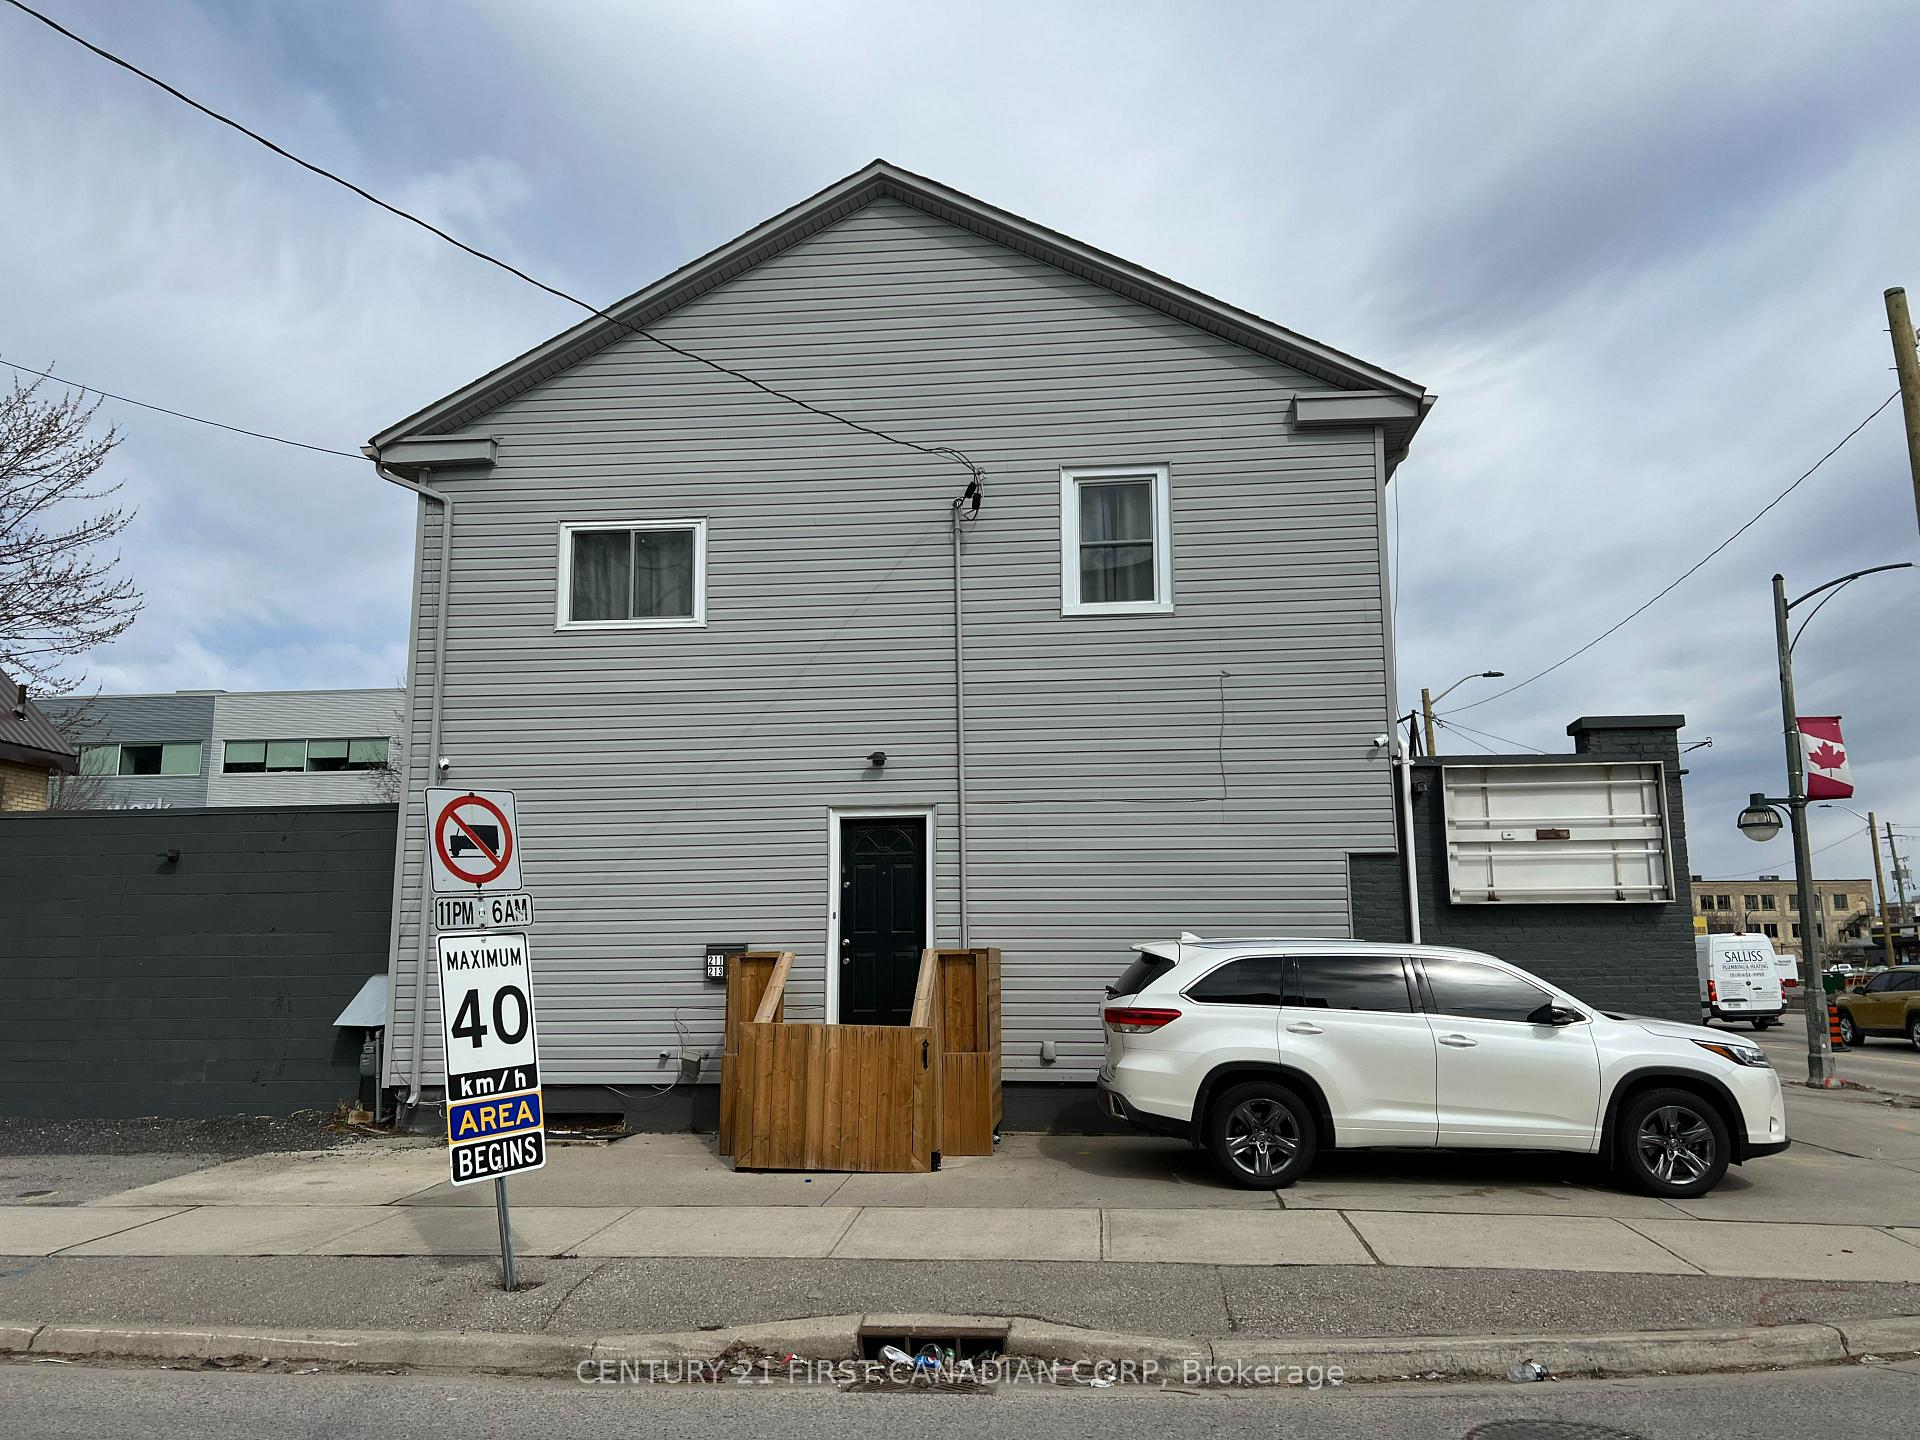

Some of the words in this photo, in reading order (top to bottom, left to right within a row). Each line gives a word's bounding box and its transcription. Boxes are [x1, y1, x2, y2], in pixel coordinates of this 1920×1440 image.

[438, 901, 474, 926] 11PM
[446, 947, 522, 971] MAXIMUM
[708, 955, 723, 965] 211
[1724, 950, 1763, 963] SALLISS
[708, 967, 723, 976] 213
[451, 985, 529, 1049] 40
[460, 1068, 527, 1097] km/h
[458, 1100, 535, 1136] AREA
[458, 1136, 537, 1178] BEGINS
